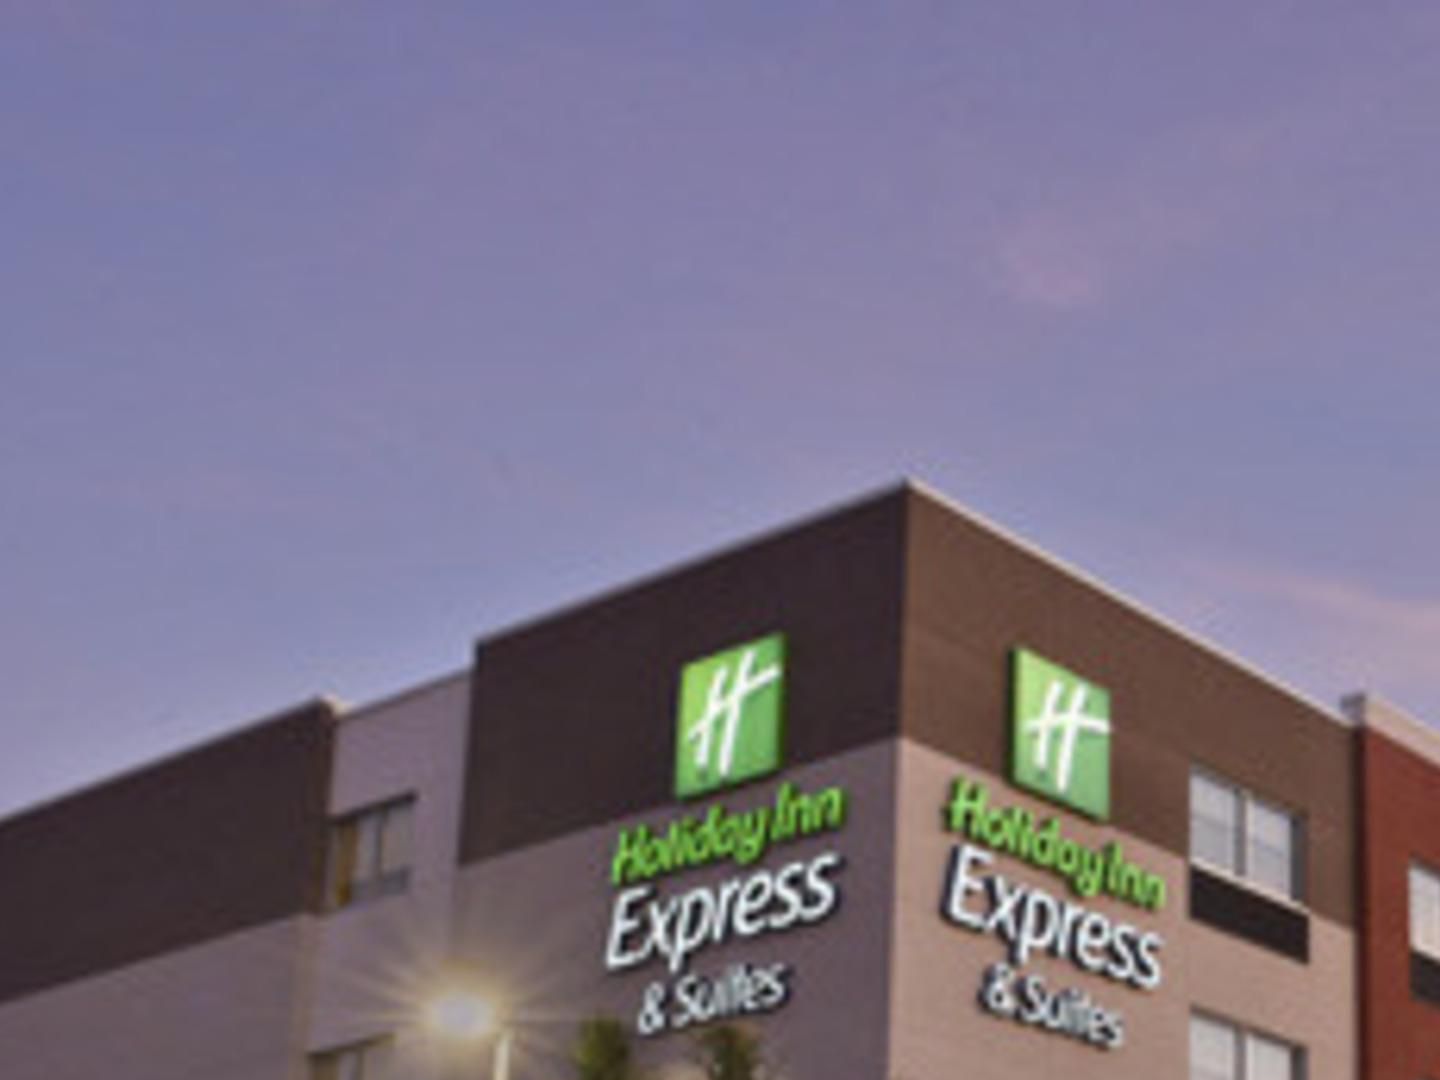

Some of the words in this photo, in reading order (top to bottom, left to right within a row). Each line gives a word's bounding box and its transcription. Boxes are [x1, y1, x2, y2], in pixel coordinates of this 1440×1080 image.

[688, 649, 781, 778] H
[1022, 680, 1113, 793] H
[611, 803, 770, 888] Holiday
[770, 782, 844, 842] Inn
[947, 775, 1104, 897] Holiday
[1104, 840, 1167, 910] Inn
[606, 851, 841, 973] Express
[948, 842, 1164, 989] Express
[637, 981, 667, 1035] &
[672, 962, 787, 1028] Suites
[981, 961, 1015, 1015] &
[1020, 972, 1124, 1048] Suites
